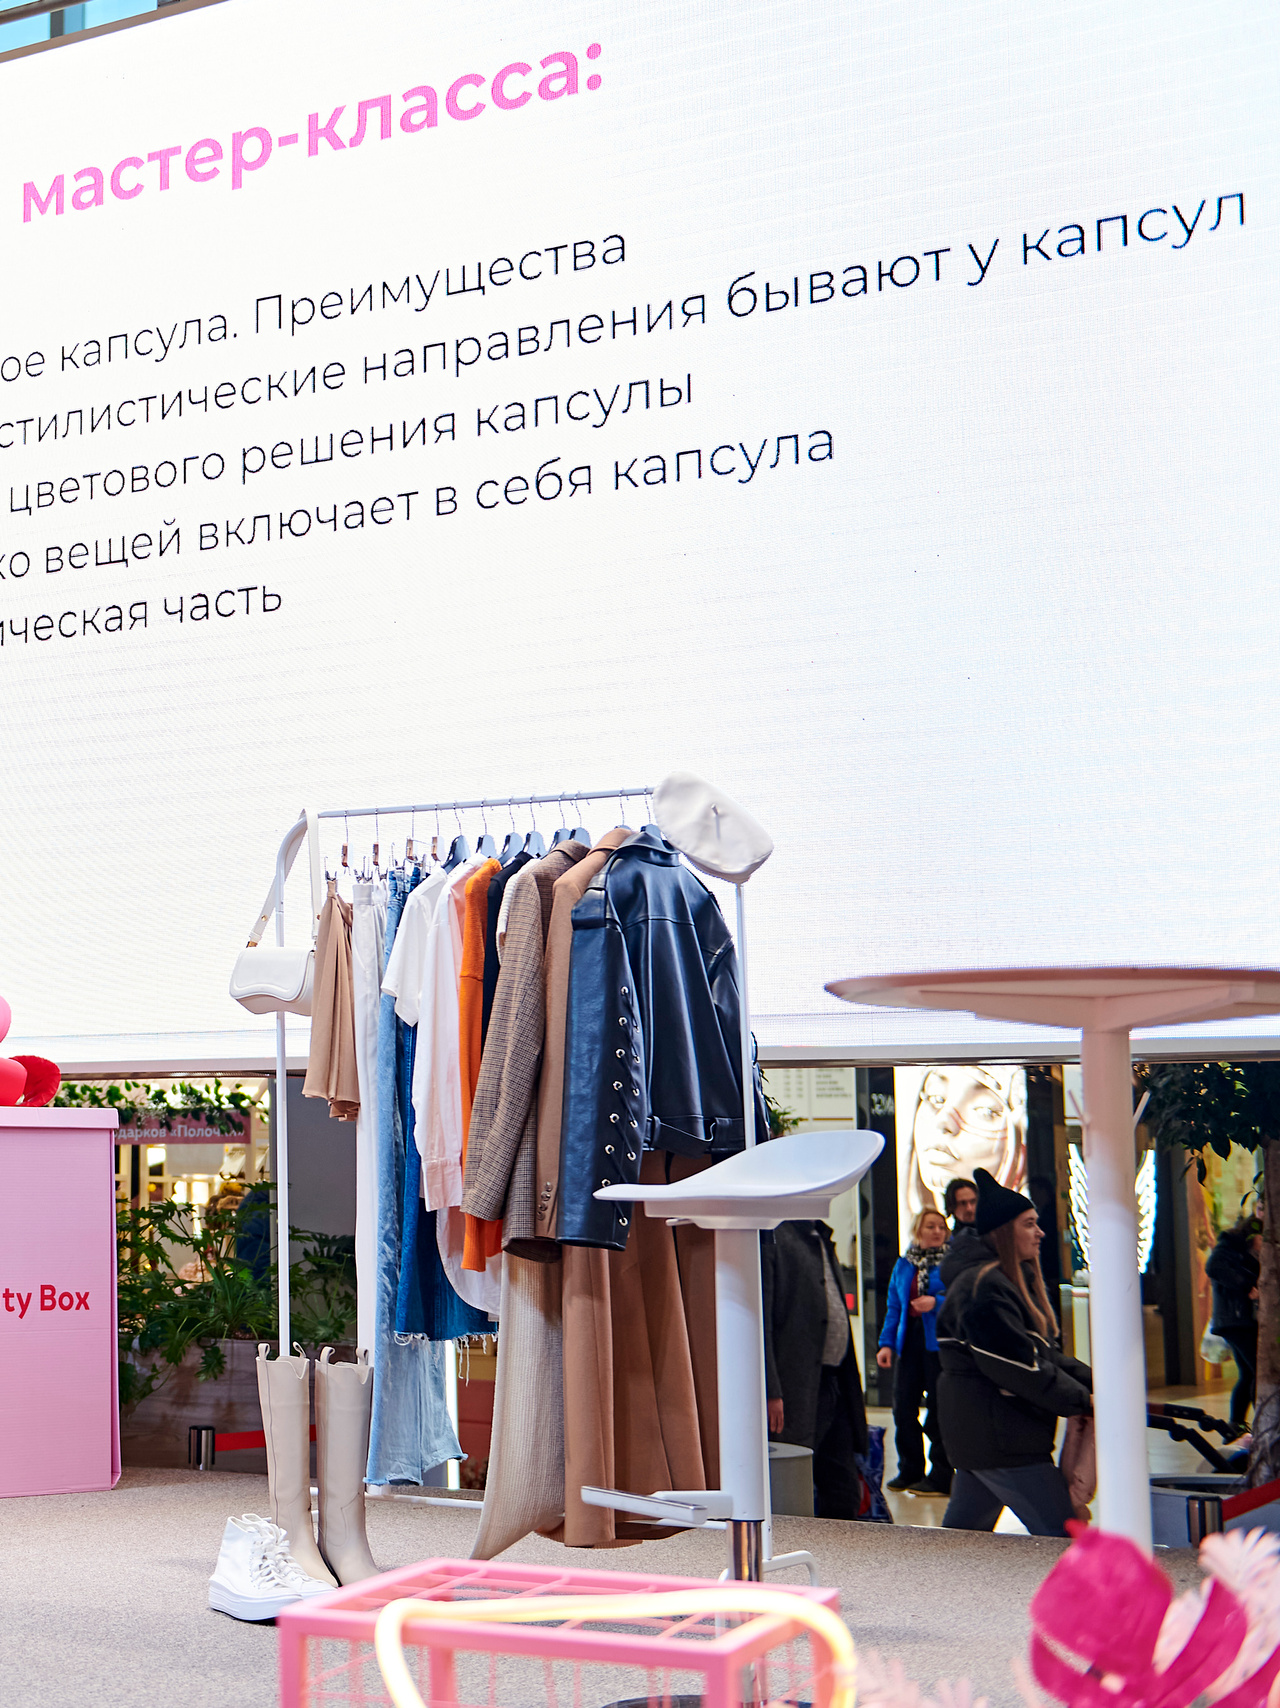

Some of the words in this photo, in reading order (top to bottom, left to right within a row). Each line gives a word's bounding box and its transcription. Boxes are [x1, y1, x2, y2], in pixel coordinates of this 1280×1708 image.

[22, 42, 603, 224] мастер-класса:
[61, 314, 238, 372] капсула.
[255, 233, 626, 337] Преимущества
[364, 294, 706, 385] направления
[727, 247, 951, 318] бывают
[966, 238, 1000, 287] у
[1022, 192, 1245, 266] капсул
[9, 452, 225, 517] цветового
[241, 412, 456, 486] решения
[476, 373, 692, 437] капсулы
[45, 518, 181, 574] вещей
[199, 490, 419, 551] включает
[435, 485, 458, 517] в
[476, 456, 592, 510] себя
[614, 429, 833, 491] капсула
[163, 585, 282, 624] часть
[114, 1126, 166, 1141] дарков
[39, 1284, 90, 1312] Box
